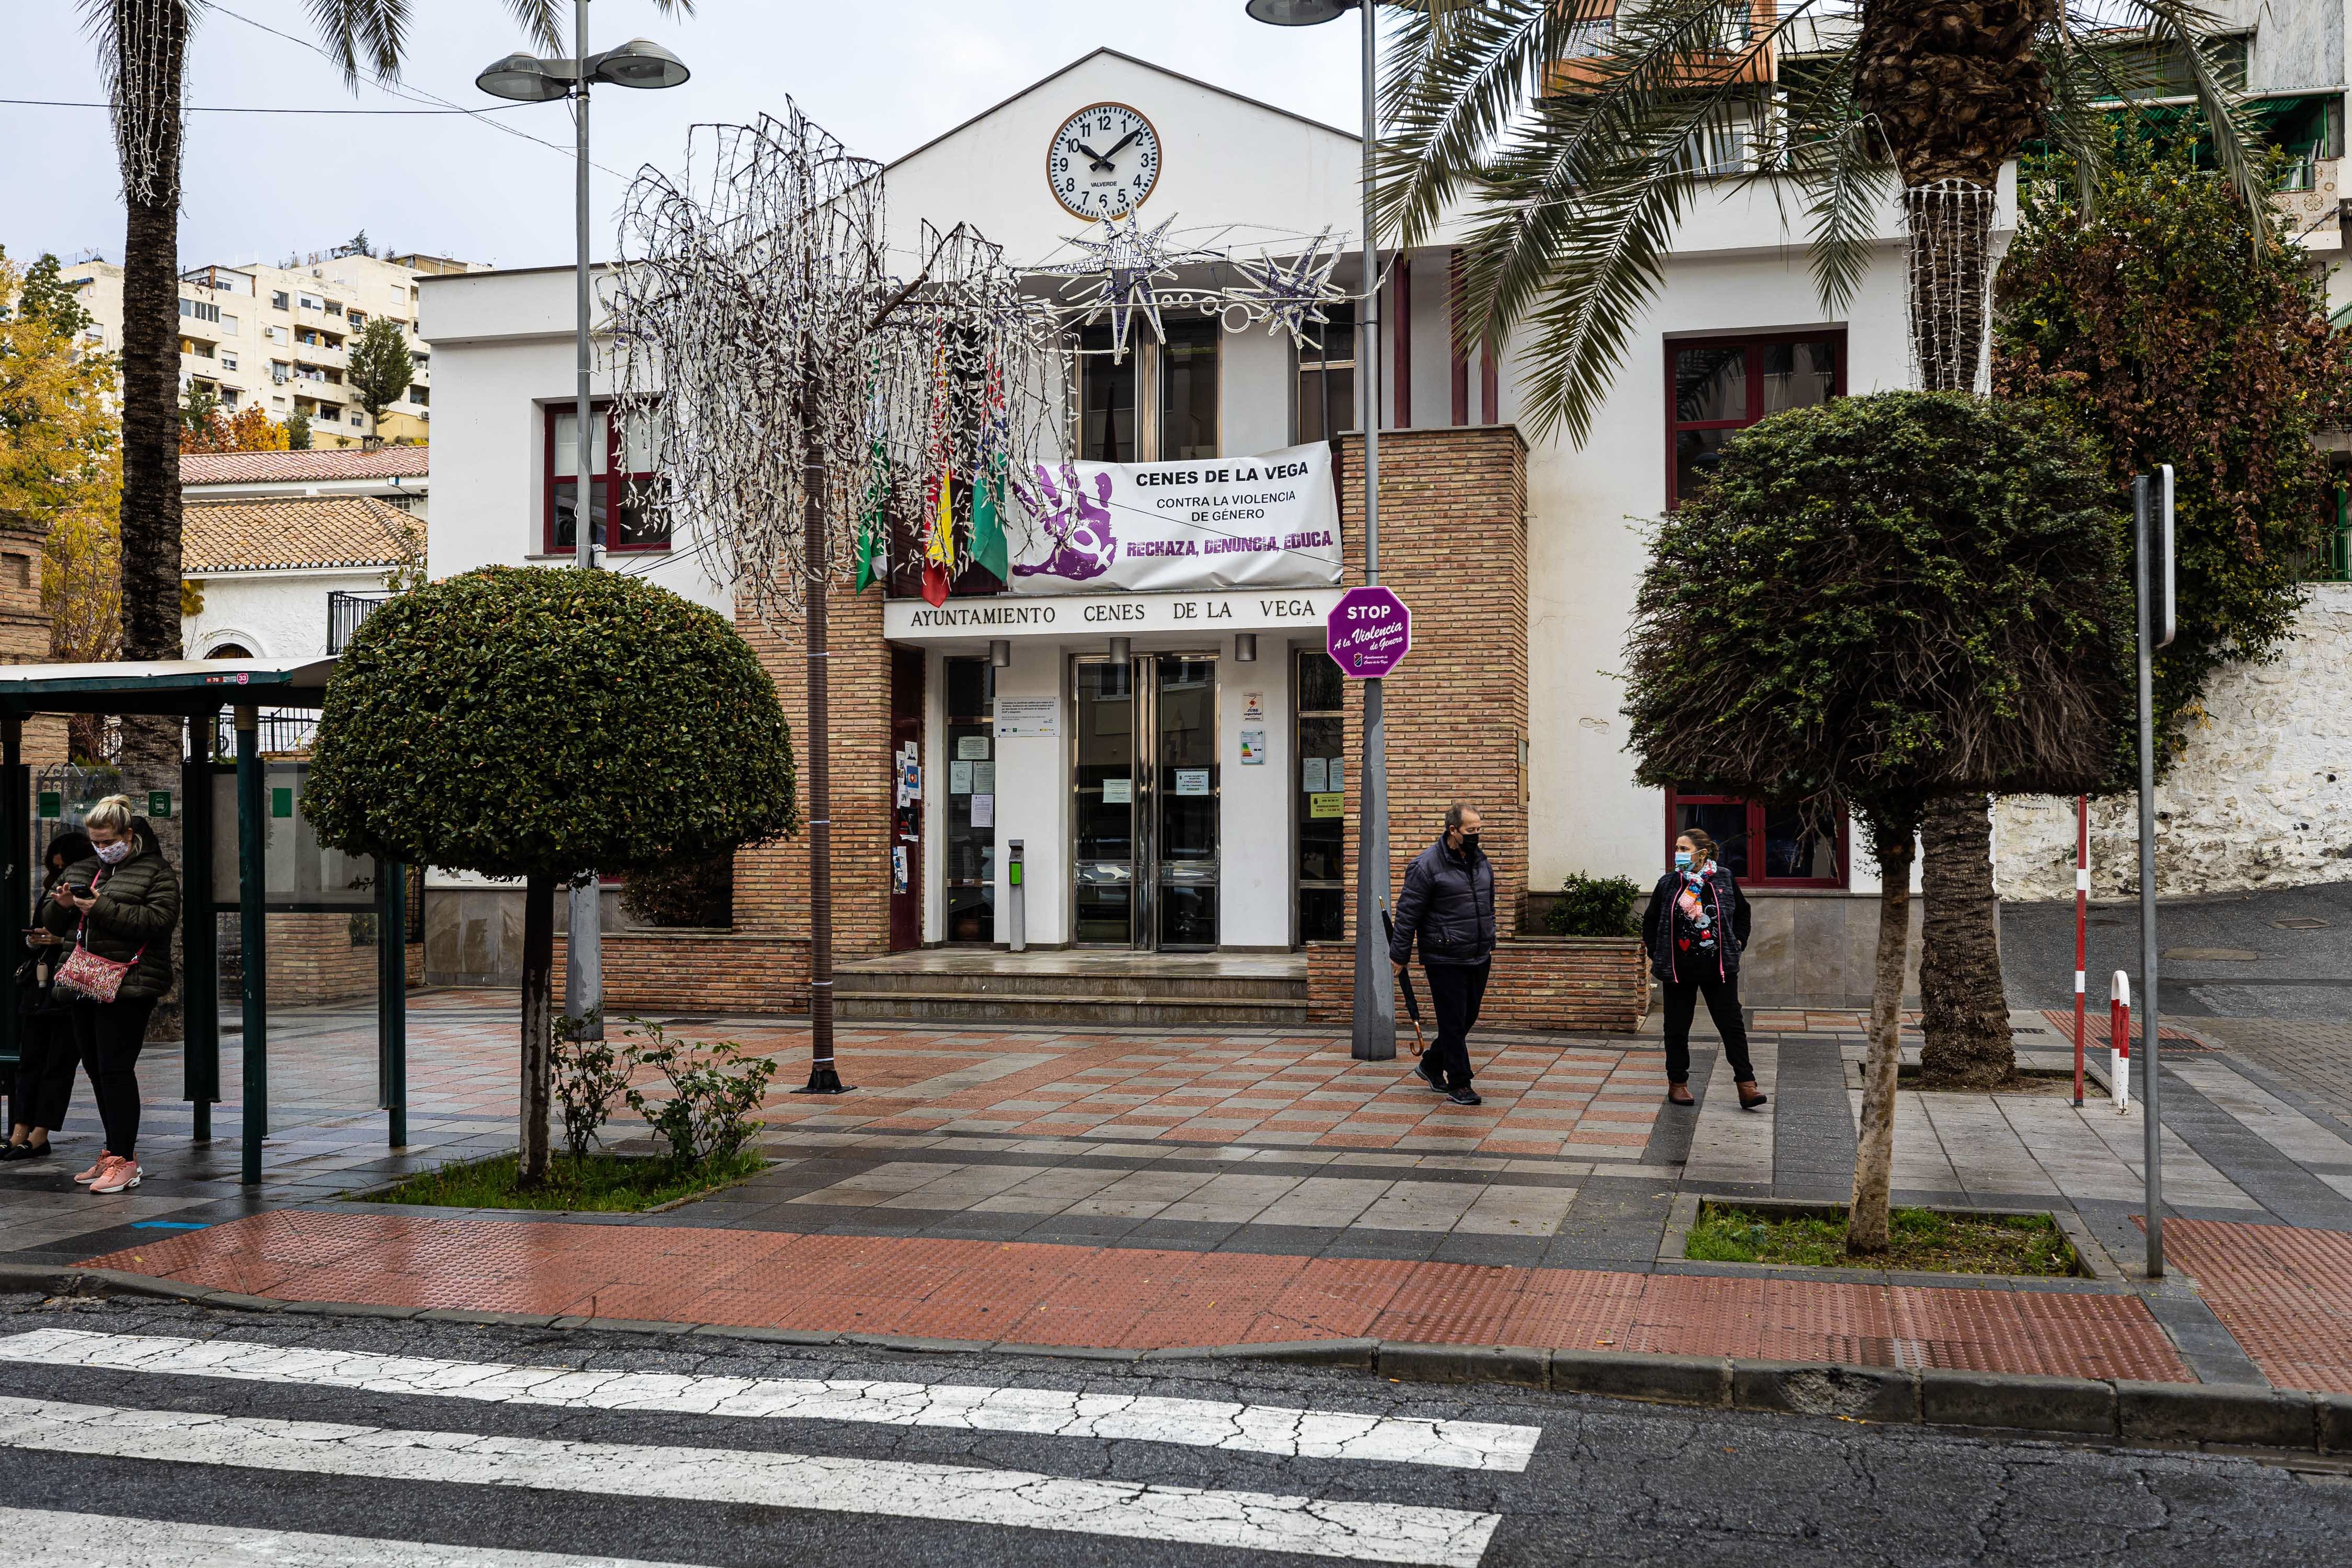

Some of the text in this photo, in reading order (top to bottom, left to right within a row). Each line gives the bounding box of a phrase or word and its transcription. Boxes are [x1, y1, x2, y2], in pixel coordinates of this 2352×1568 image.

[1080, 123, 1091, 137] 11
[1097, 116, 1111, 130] 12
[1121, 119, 1126, 133] 1
[1066, 139, 1080, 153] 10
[1135, 133, 1144, 146] 2
[1059, 157, 1068, 172] 9
[1140, 153, 1149, 168] 3
[1066, 177, 1075, 192] 8
[1133, 174, 1142, 188] 4
[1081, 191, 1090, 205] 7
[1099, 194, 1108, 208] 6
[1117, 189, 1126, 203] 5
[1136, 462, 1308, 487] CENES DE LA VEGA
[1157, 490, 1296, 509] CONTRA LA VIOLENCIA
[1192, 509, 1264, 522] DE GÉNERO
[1127, 540, 1199, 558] RECHAZA,
[1204, 536, 1279, 554] DENUNCIA,
[911, 599, 1316, 626] AYUNTAMIENTO CENES DE LA VEGA
[1347, 605, 1390, 619] STOP
[1333, 621, 1403, 651] A la Violencia
[1370, 641, 1378, 651] de
